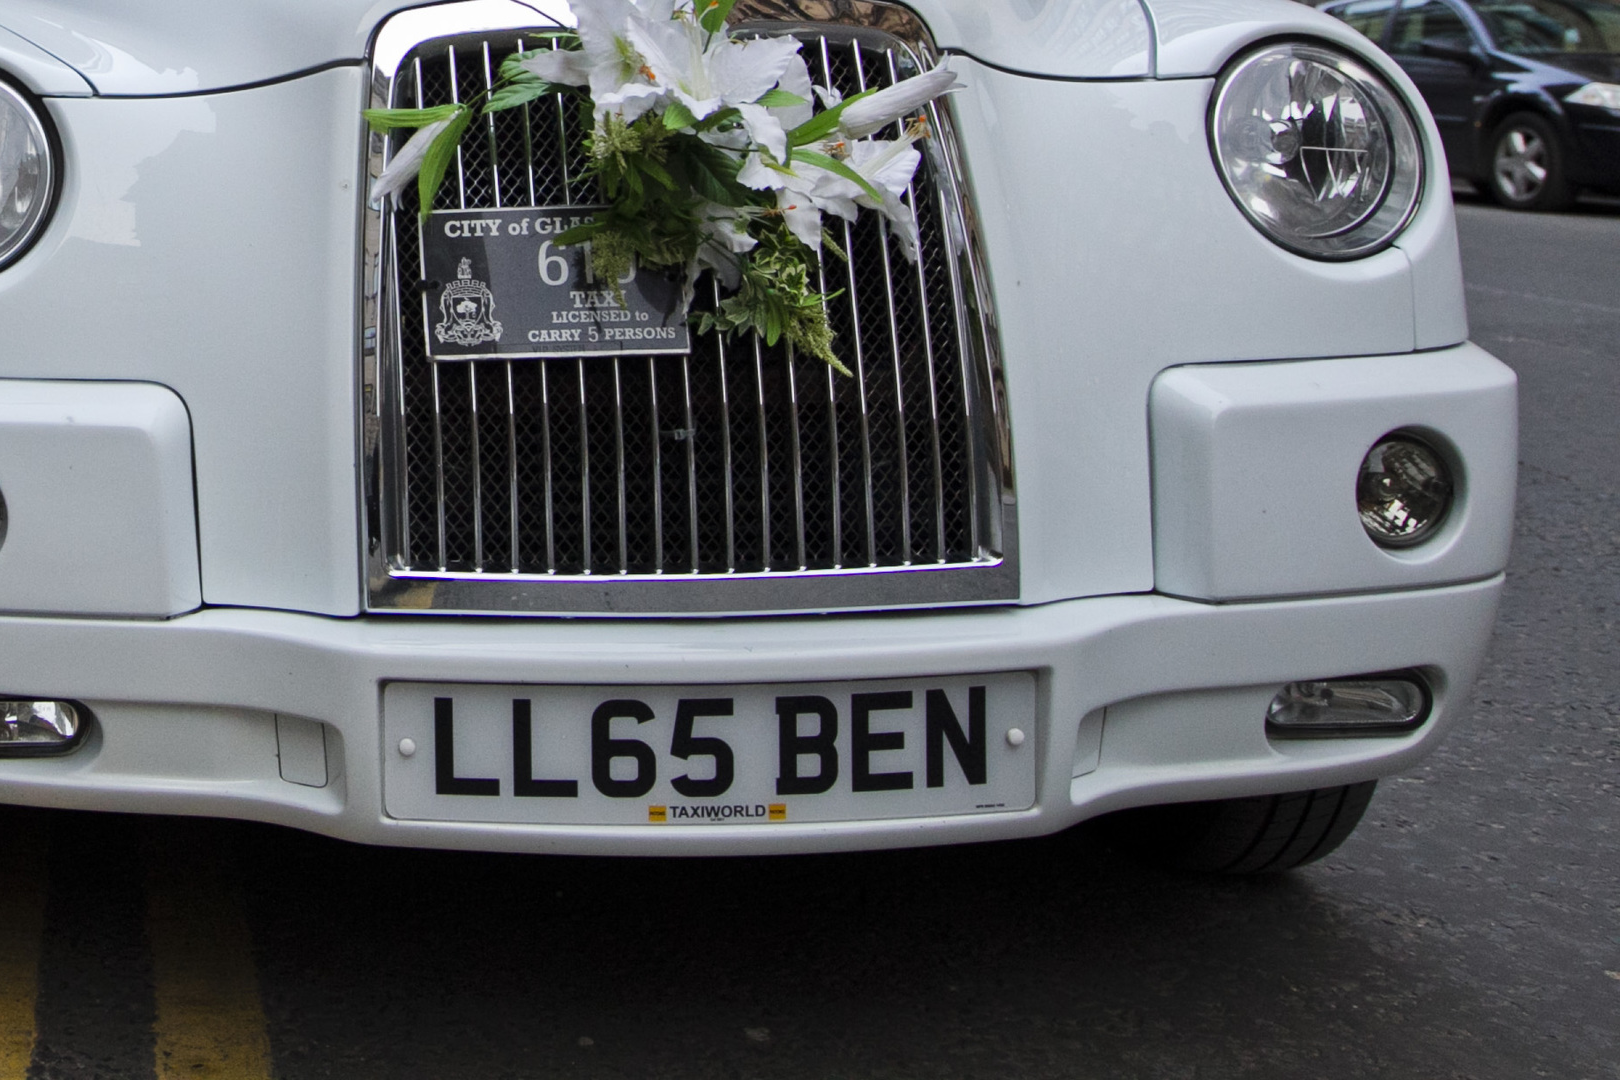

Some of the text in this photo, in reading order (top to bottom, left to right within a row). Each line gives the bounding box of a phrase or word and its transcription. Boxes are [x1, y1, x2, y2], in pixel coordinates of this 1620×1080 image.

[444, 218, 502, 238] CITY
[508, 218, 530, 236] of
[551, 310, 649, 323] LICENSED to
[528, 326, 676, 342] CARRY 5 PERSONS
[434, 685, 987, 798] LL65 BEN
[670, 805, 766, 818] TAXIWORLD
